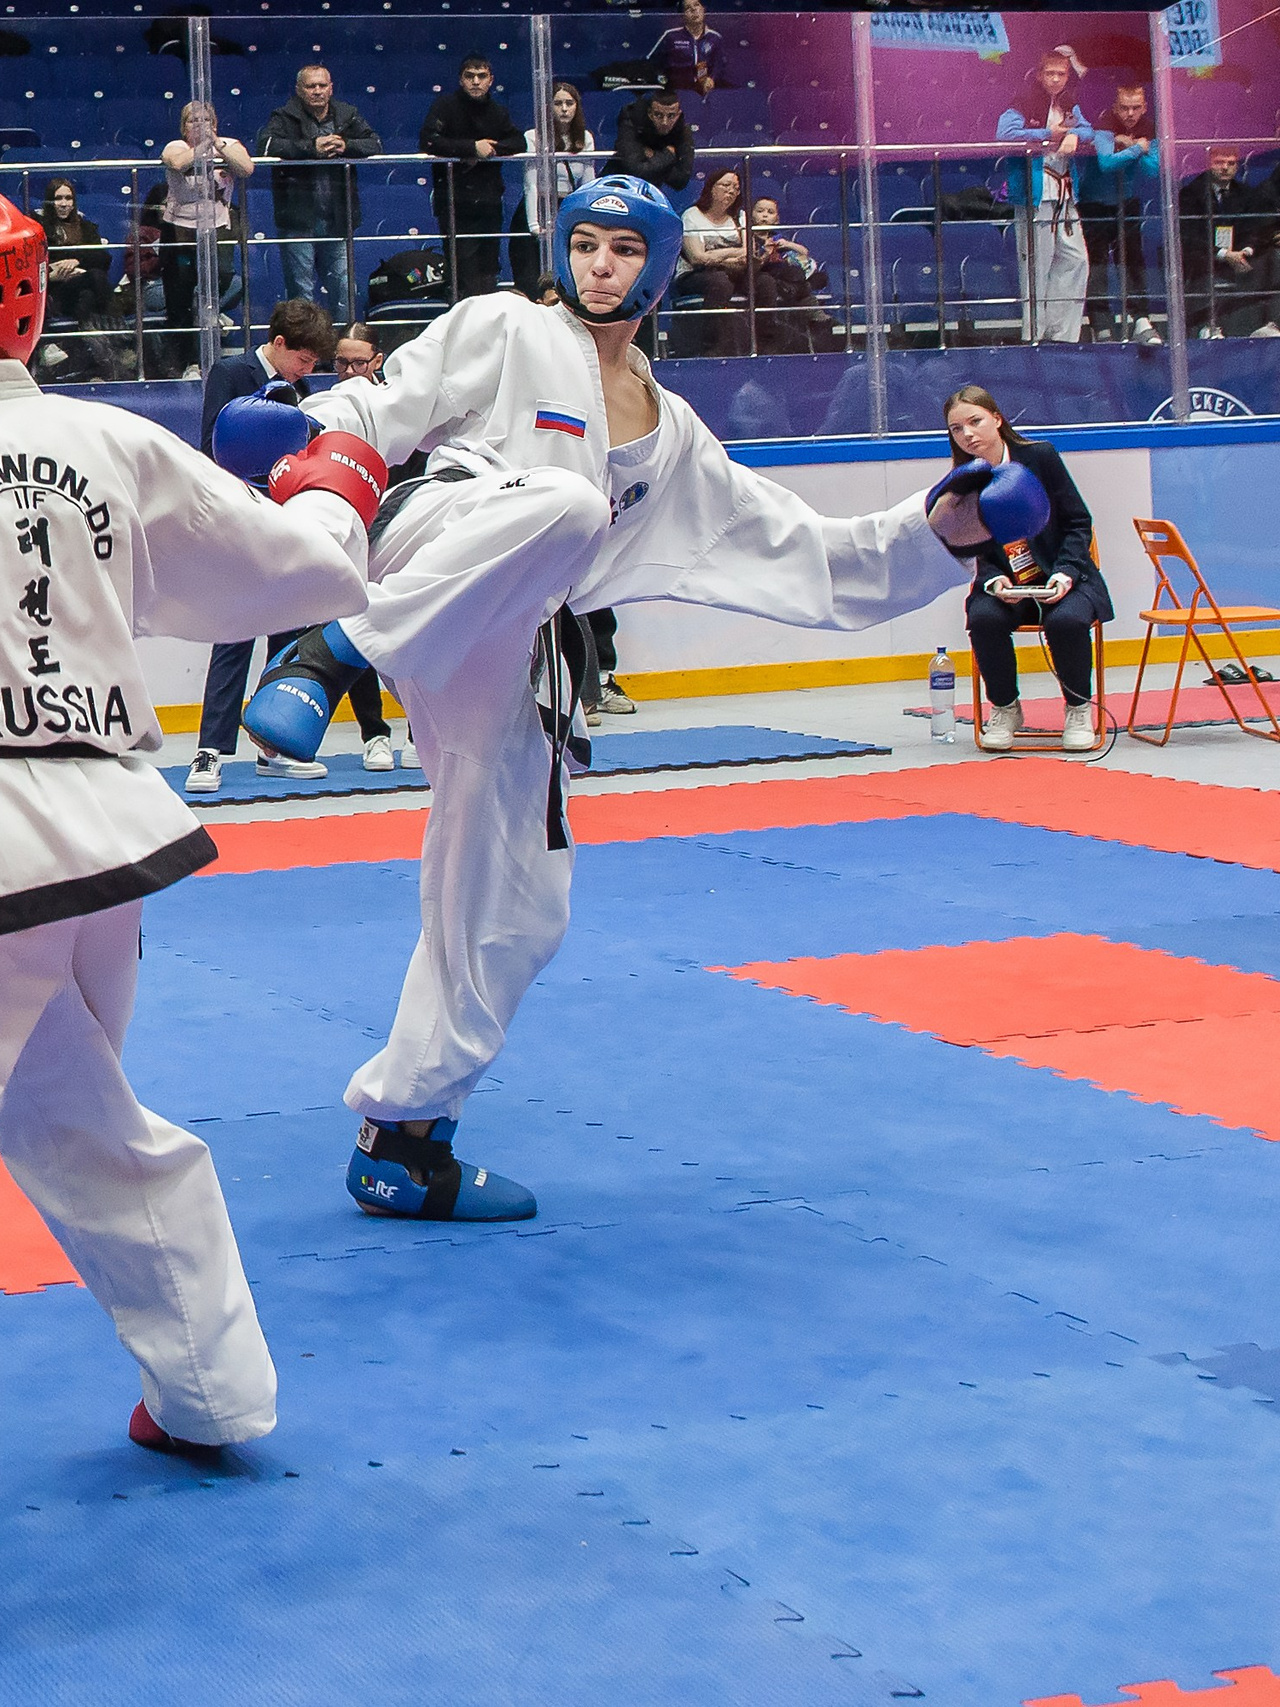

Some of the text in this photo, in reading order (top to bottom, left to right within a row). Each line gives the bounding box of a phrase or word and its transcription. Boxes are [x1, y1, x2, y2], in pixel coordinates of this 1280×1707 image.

[596, 198, 626, 210] TOP TEN
[309, 699, 324, 718] PRO
